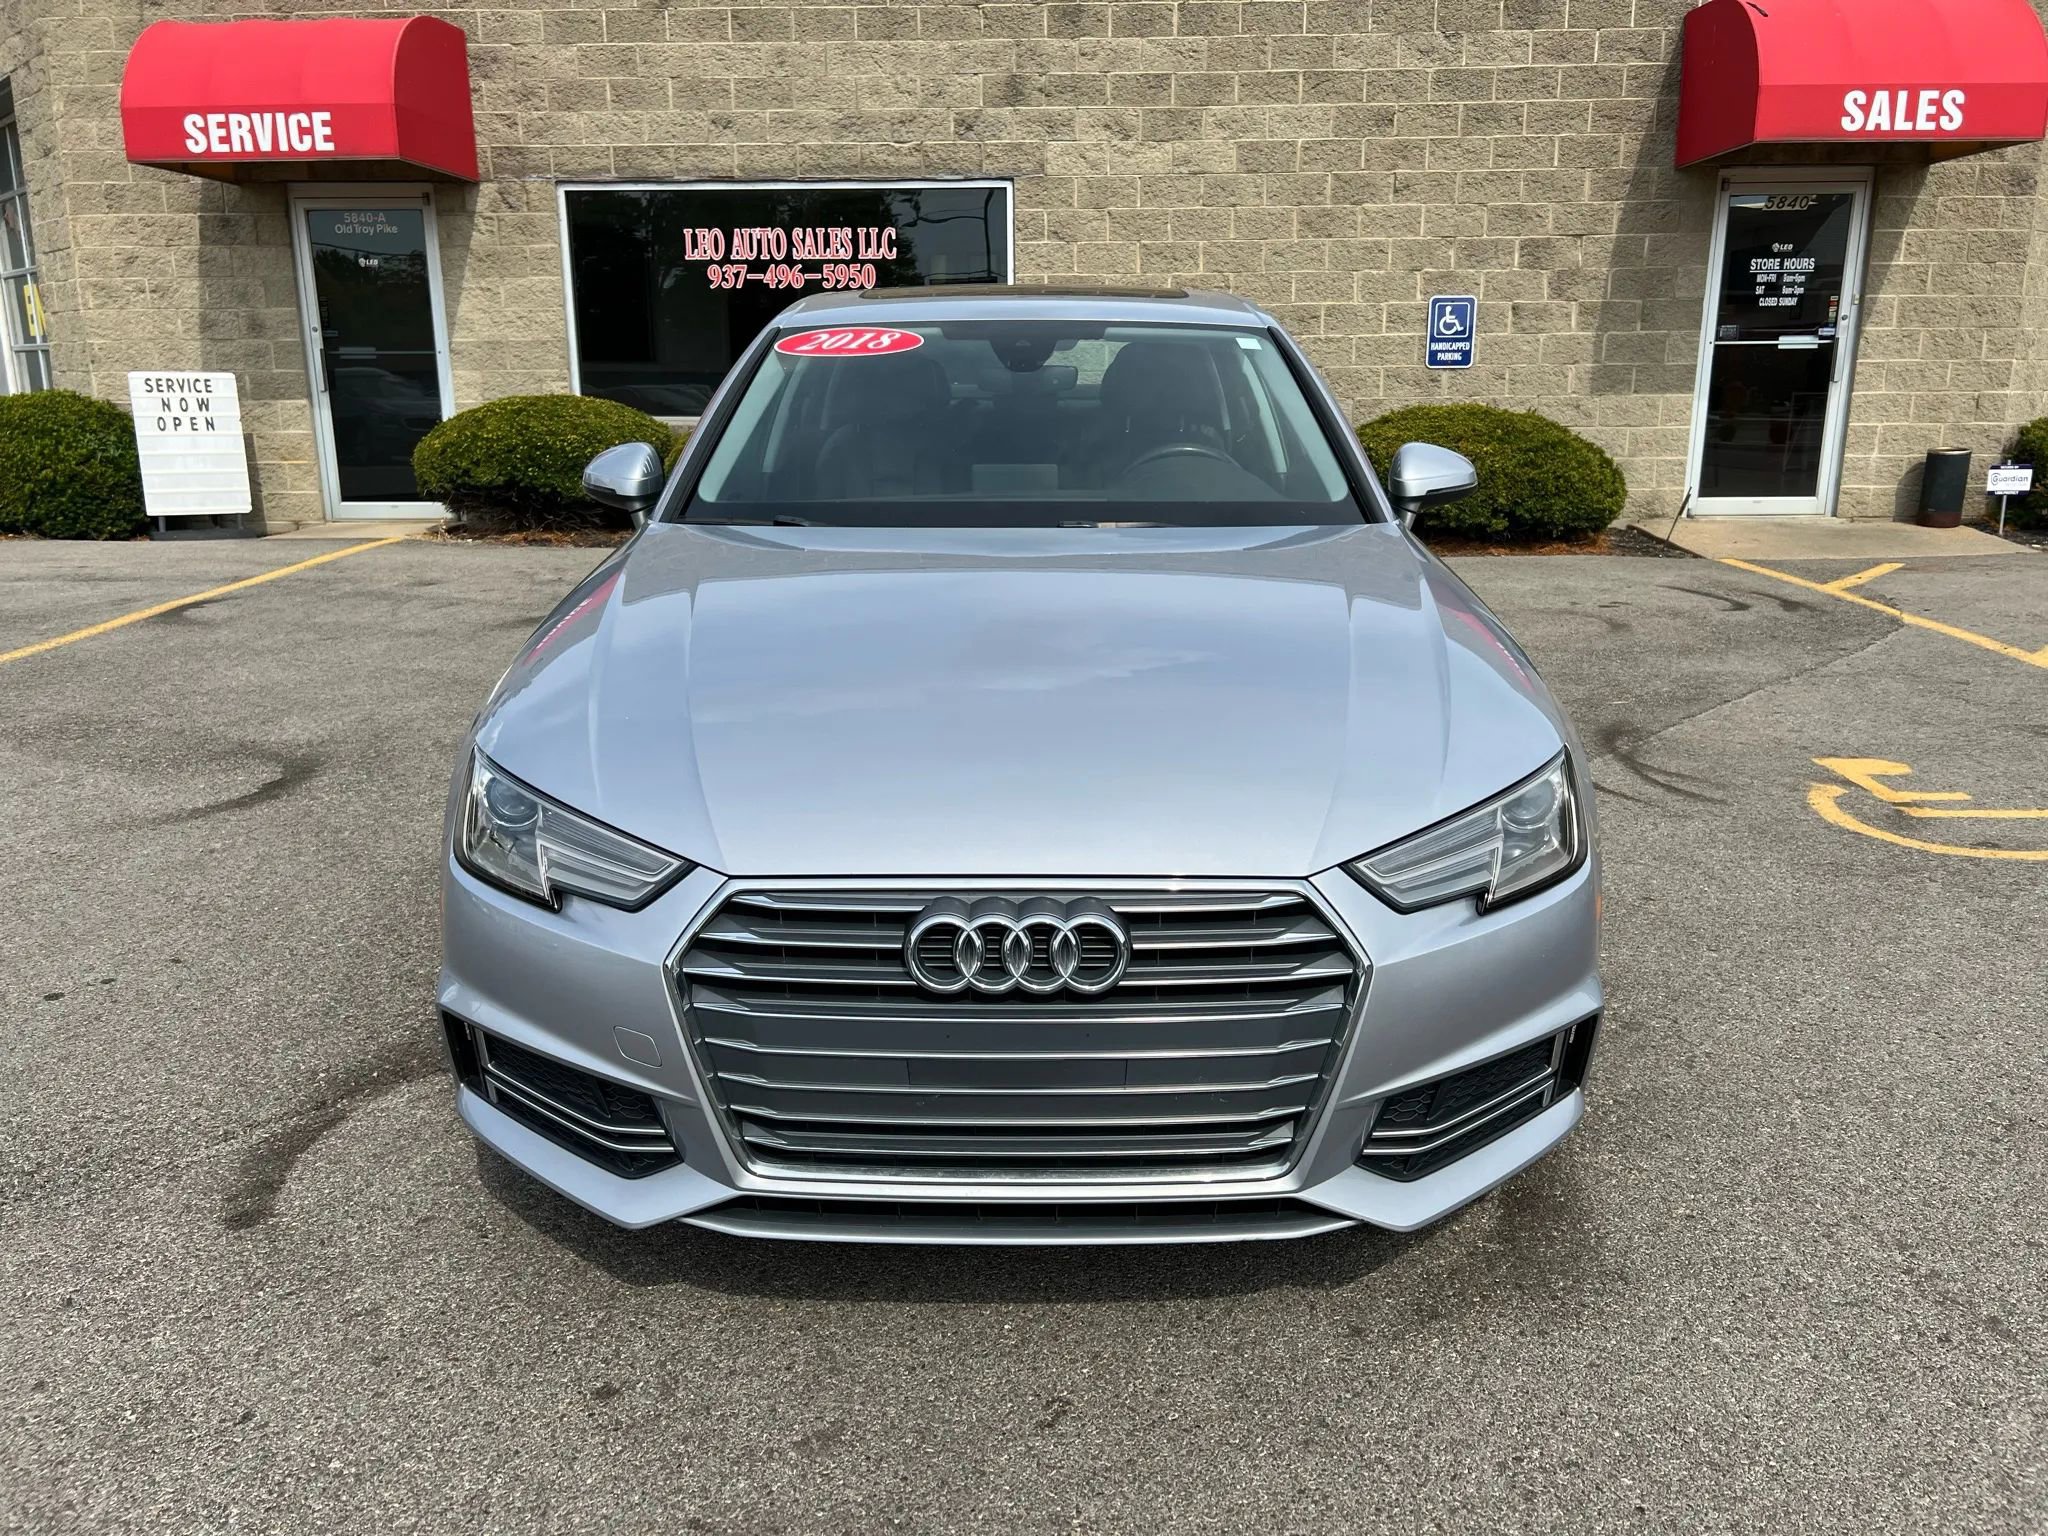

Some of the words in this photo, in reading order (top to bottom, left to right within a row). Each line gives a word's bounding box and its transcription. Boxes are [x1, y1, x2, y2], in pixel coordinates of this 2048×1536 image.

[1841, 90, 1965, 131] SALES
[183, 112, 335, 153] SERVICE
[1764, 195, 1810, 209] 5840
[343, 212, 386, 223] 5840-A
[334, 224, 353, 234] Old
[353, 224, 374, 236] Troy
[376, 224, 398, 234] Pike
[683, 228, 725, 260] LEO
[730, 227, 787, 260] AUTO
[792, 227, 853, 260] SALES
[858, 227, 897, 259] LLC
[1779, 243, 1794, 251] LEO
[1750, 258, 1781, 271] STORE
[1783, 258, 1815, 270] HOURS
[707, 264, 876, 289] 937-496-5950
[1756, 274, 1777, 283] MON-FRI
[1755, 285, 1765, 295] SAT
[1759, 297, 1777, 307] CLOSED
[1778, 297, 1798, 306] SUNDAY
[795, 332, 901, 351] 2018
[1430, 342, 1470, 351] HANDICAPPED
[1437, 352, 1462, 361] PARKING
[144, 378, 213, 393] SERVICE
[161, 397, 210, 412] NOW
[157, 416, 215, 432] OPEN
[1991, 473, 2029, 484] Guardian
